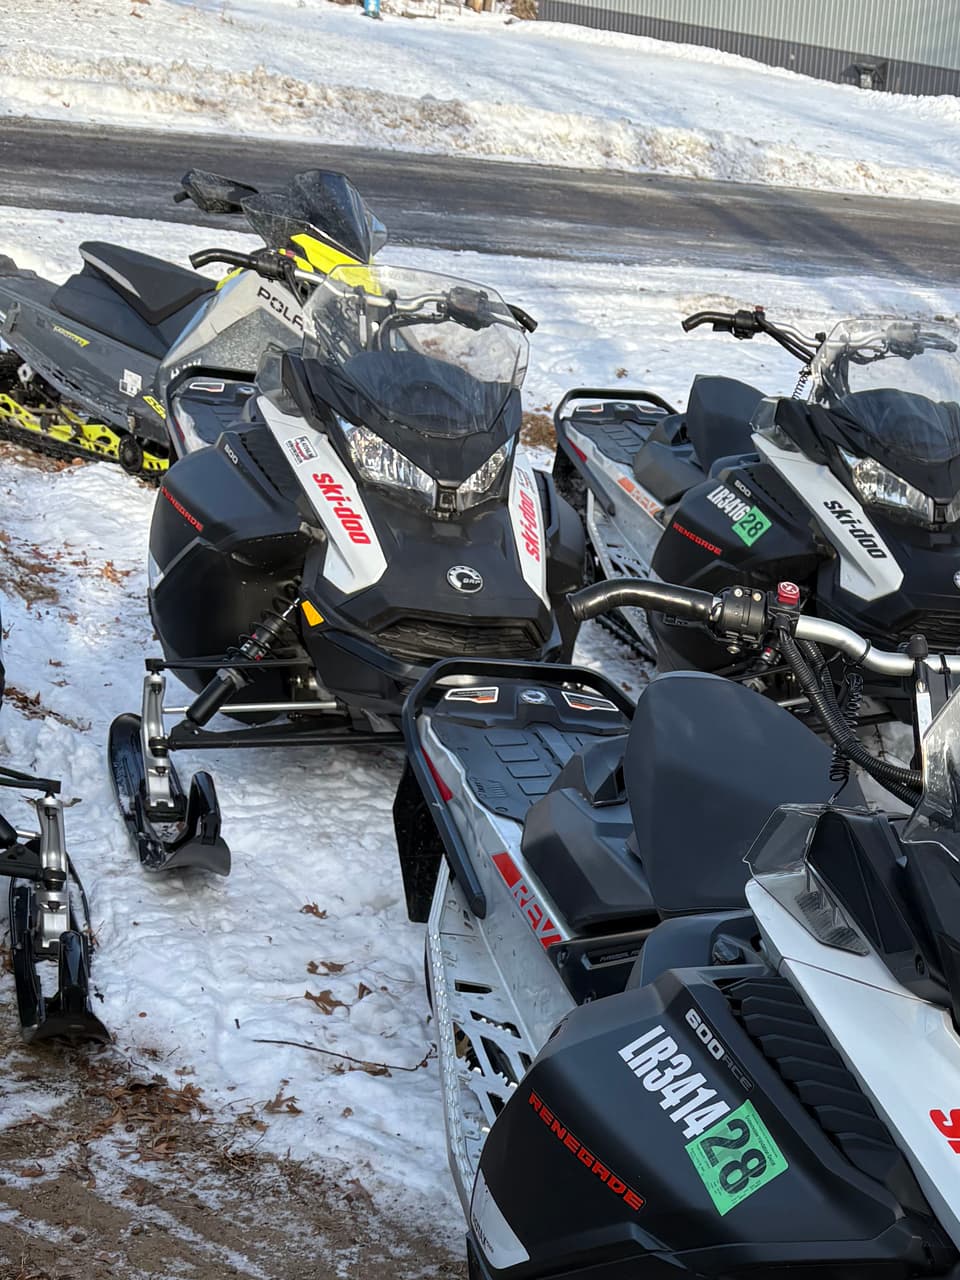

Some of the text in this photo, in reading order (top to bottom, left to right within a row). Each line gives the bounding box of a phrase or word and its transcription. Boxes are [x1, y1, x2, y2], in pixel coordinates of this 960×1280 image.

[257, 286, 304, 331] POLA
[312, 472, 372, 545] ski-doo
[519, 489, 541, 562] ski-doo
[672, 522, 723, 556] RENEGADE
[706, 485, 751, 521] LR3416
[740, 513, 765, 539] 28
[823, 500, 888, 559] ski-doo
[508, 874, 562, 947] REV
[617, 1024, 731, 1140] LR3414
[685, 1008, 753, 1091] 600 ACE
[528, 1091, 644, 1211] RENEGADE
[699, 1118, 767, 1195] 28
